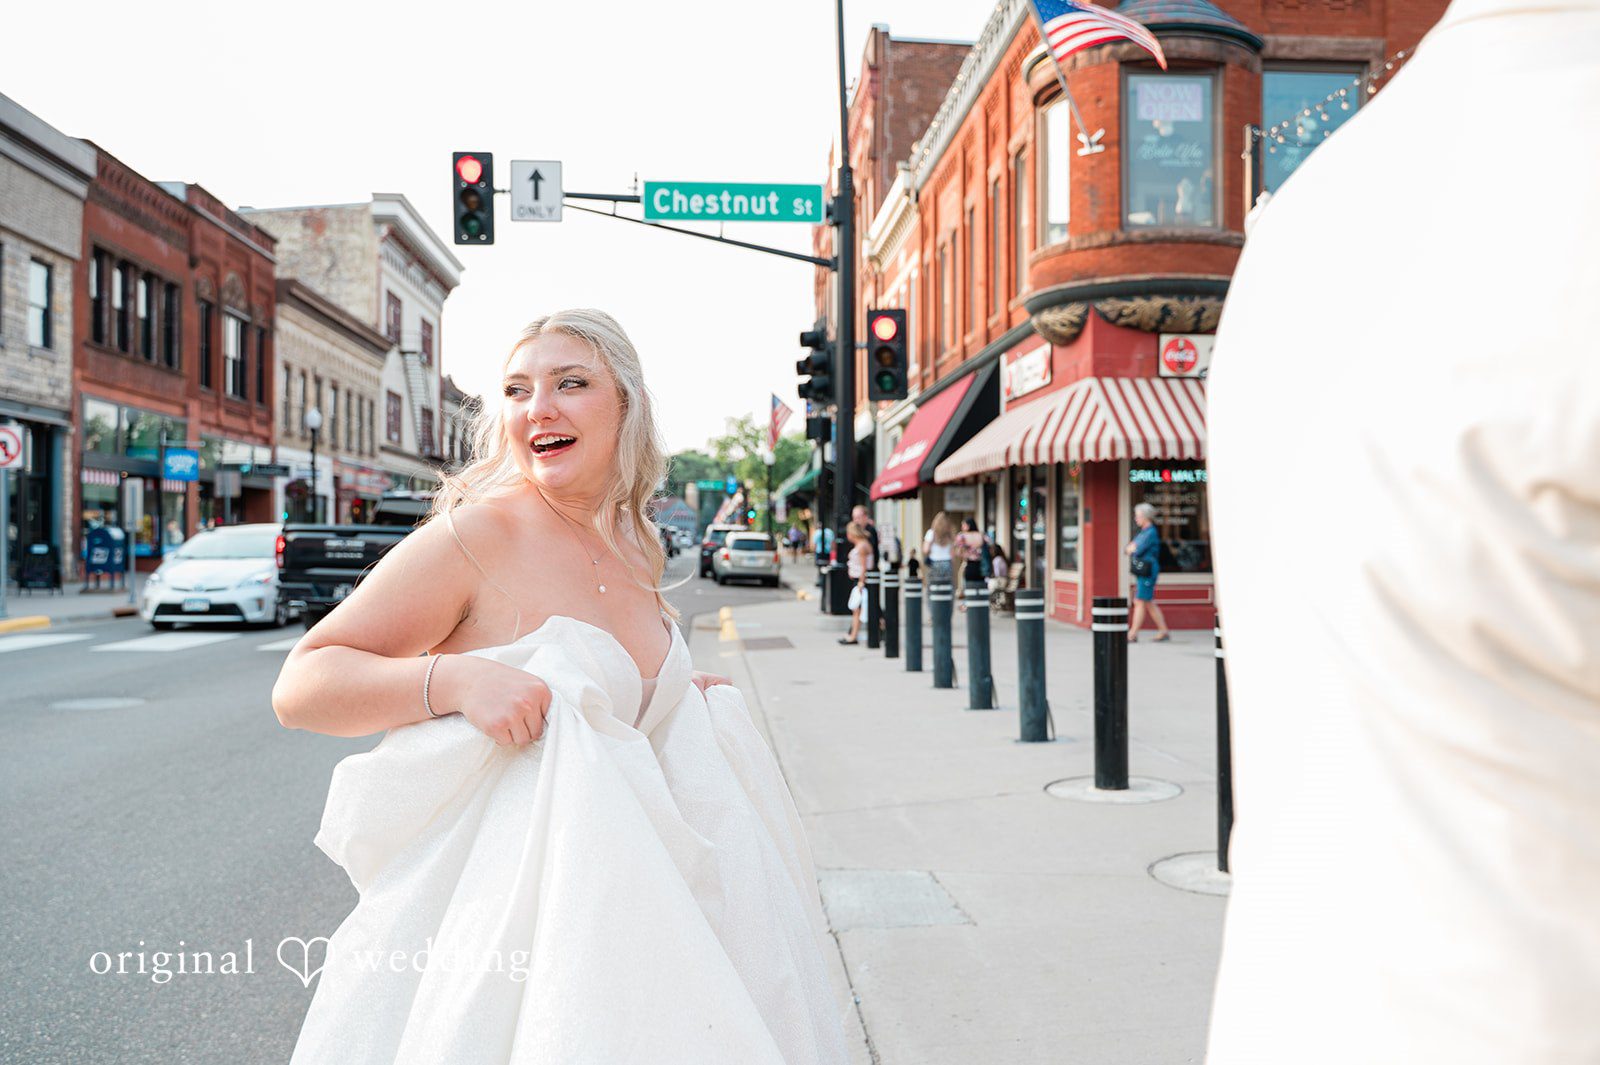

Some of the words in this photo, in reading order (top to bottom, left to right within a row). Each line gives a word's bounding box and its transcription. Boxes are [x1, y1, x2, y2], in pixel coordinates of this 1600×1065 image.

[1140, 84, 1195, 101] NOW
[1140, 103, 1199, 119] OPEN
[653, 187, 780, 216] Chestnut
[793, 196, 815, 217] St
[516, 205, 556, 219] ONLY
[1129, 469, 1161, 482] GRILL
